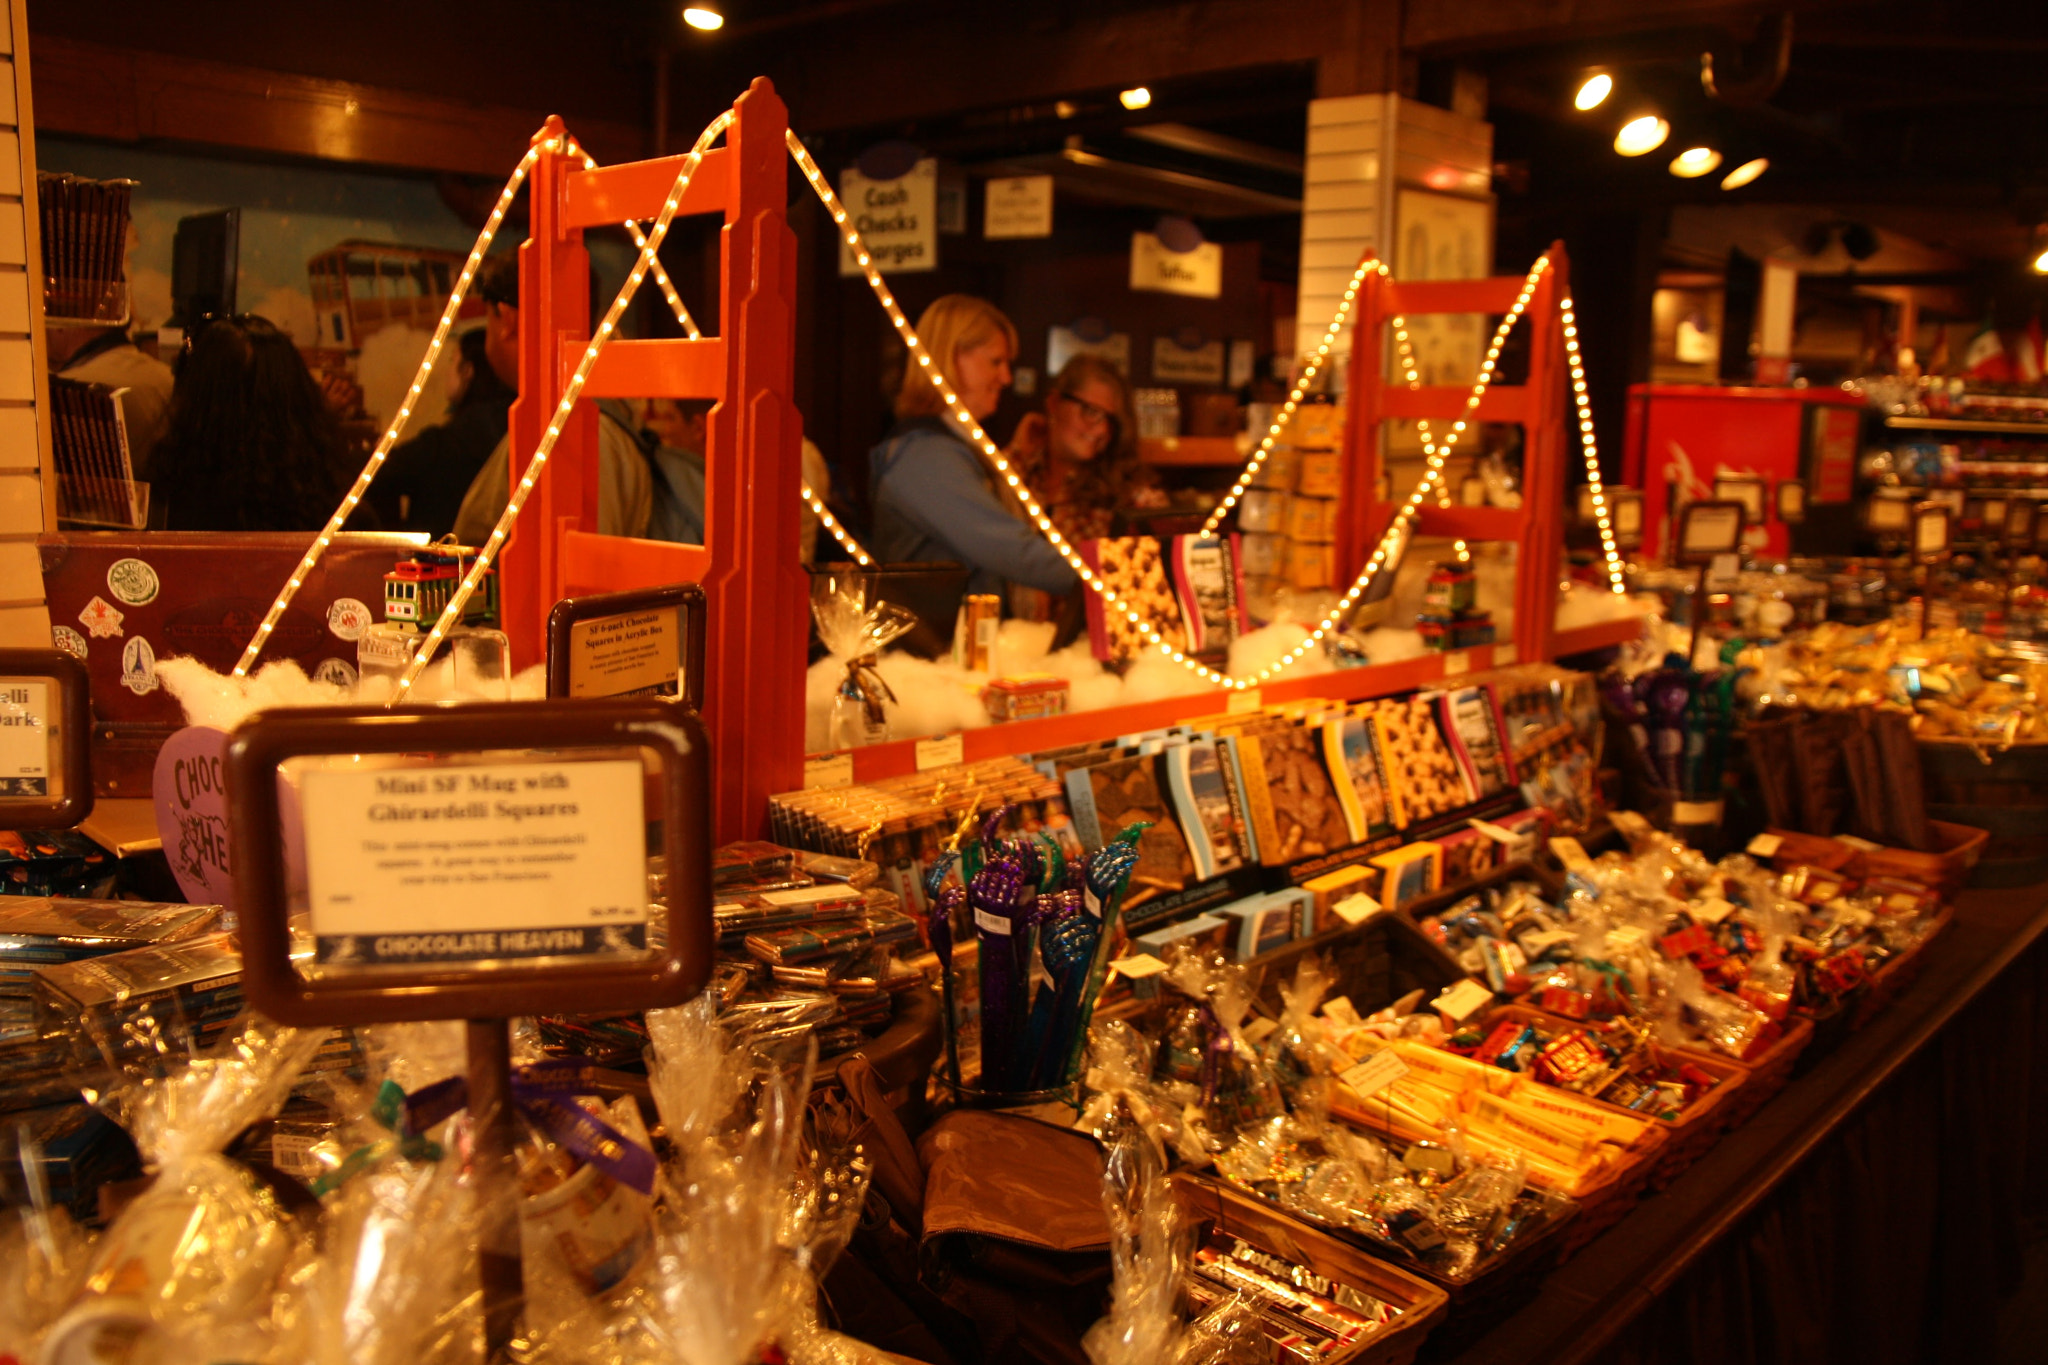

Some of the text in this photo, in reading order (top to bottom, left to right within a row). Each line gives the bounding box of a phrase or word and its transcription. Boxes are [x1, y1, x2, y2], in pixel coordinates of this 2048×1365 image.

[864, 186, 908, 208] Cash
[856, 212, 918, 233] Checks
[589, 614, 660, 636] SF 6-pack Chocolate
[585, 626, 663, 649] Squares in Acrylic Box
[0, 712, 37, 727] ark
[375, 772, 569, 796] Mini SF Mug with
[367, 799, 579, 823] Ghirardelli Squares
[374, 929, 584, 958] CHOCOLATE HEAVEN
[1231, 1239, 1293, 1279] Tootsie
